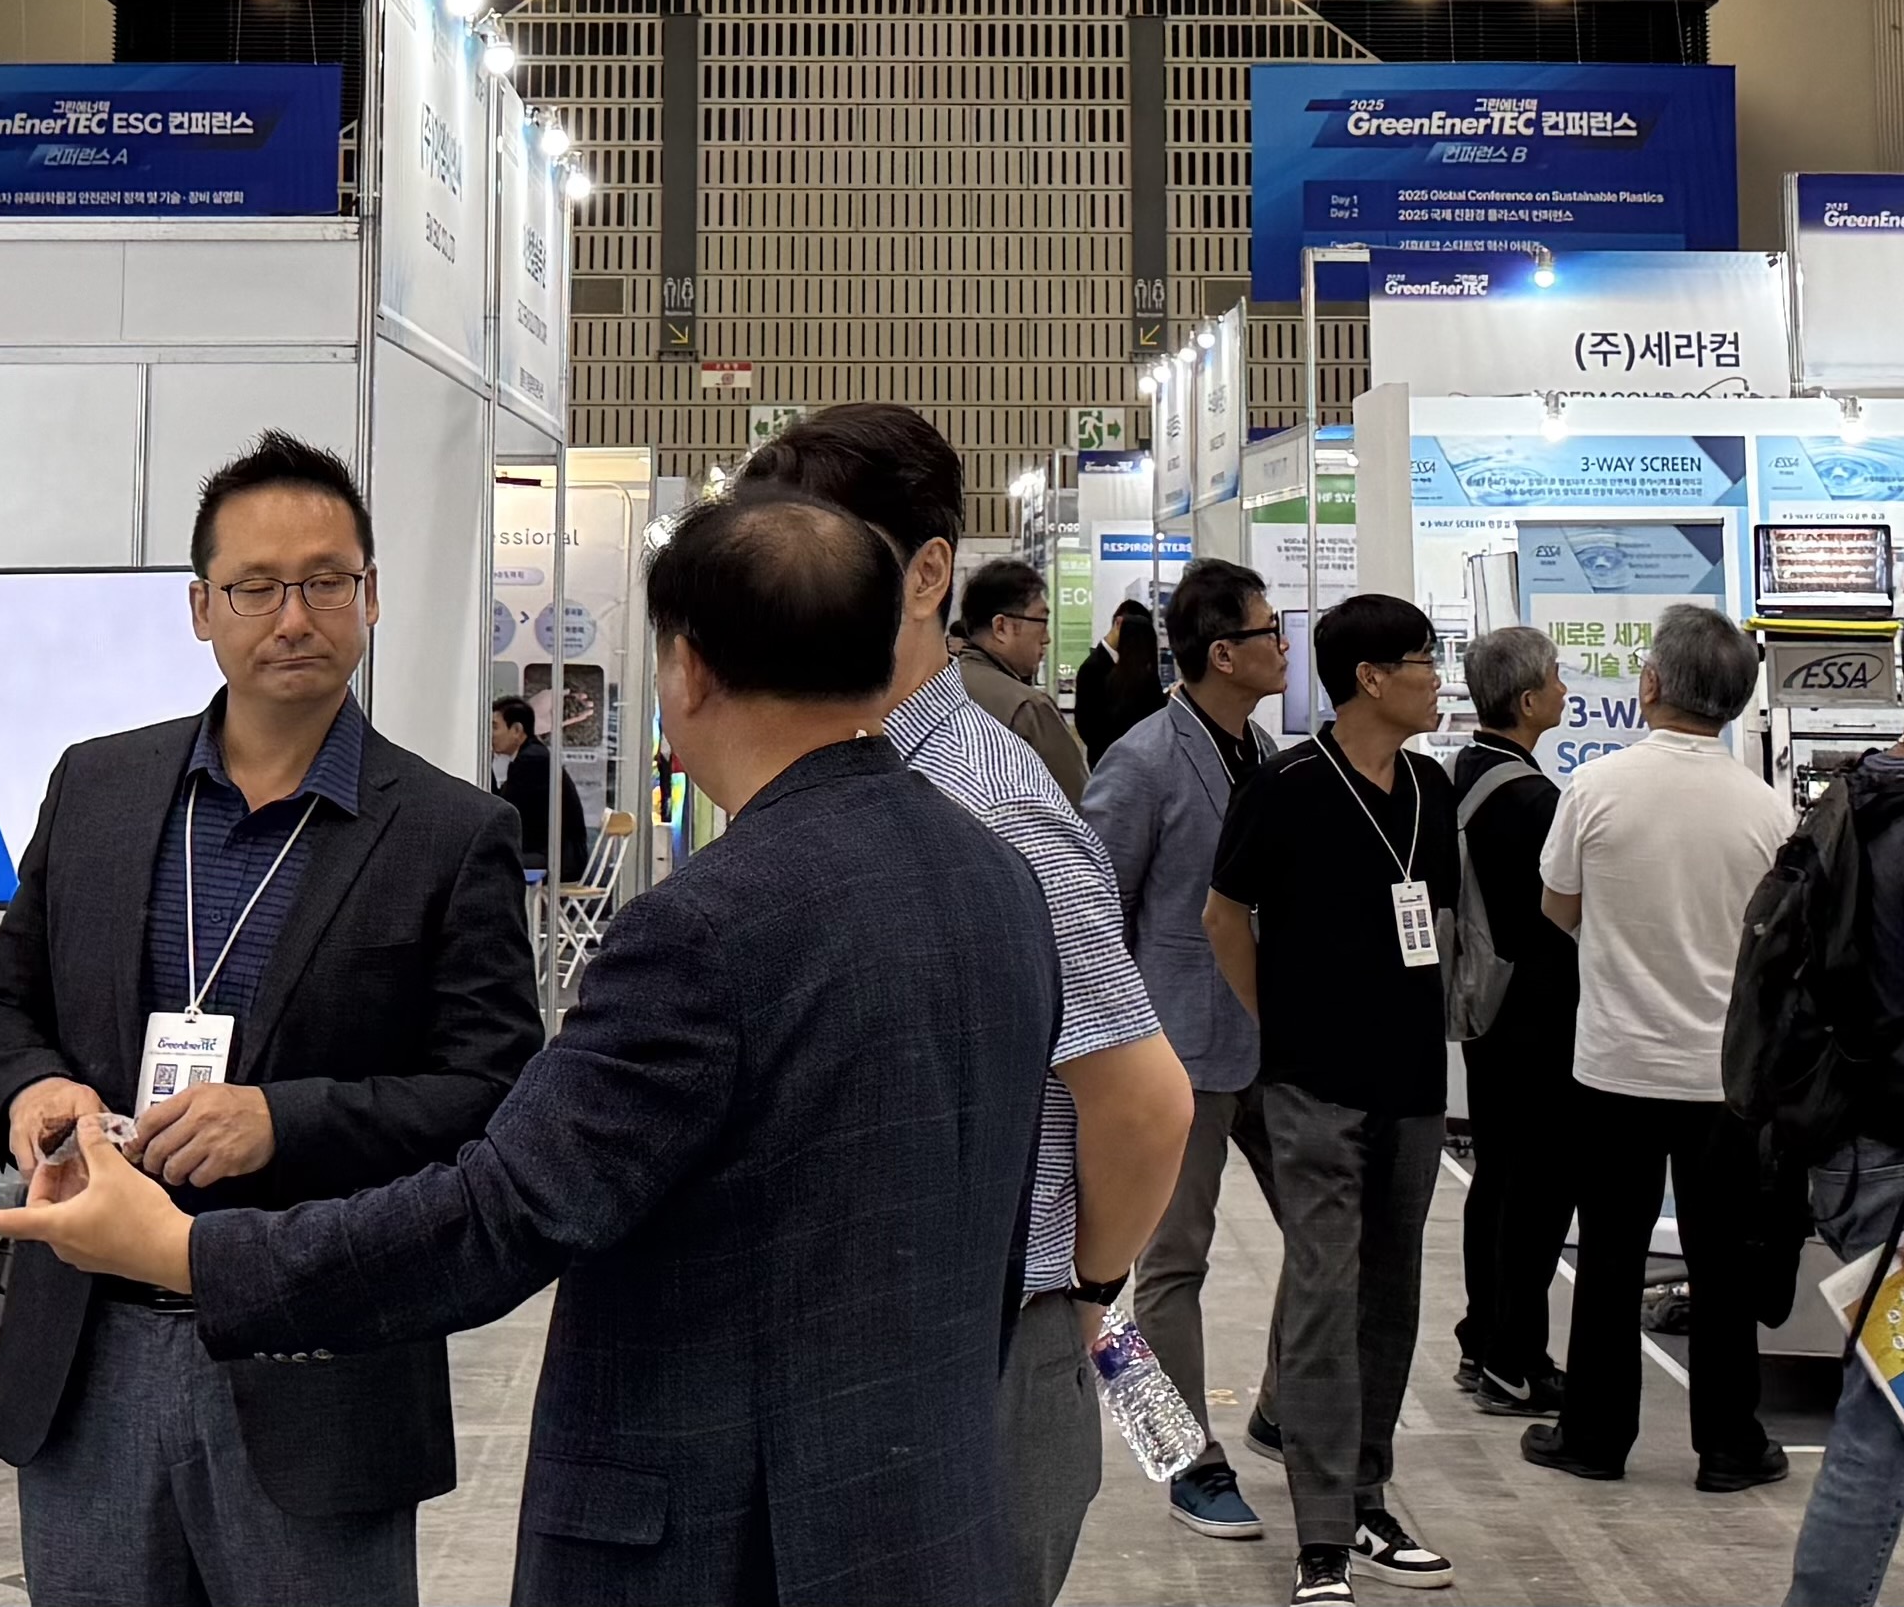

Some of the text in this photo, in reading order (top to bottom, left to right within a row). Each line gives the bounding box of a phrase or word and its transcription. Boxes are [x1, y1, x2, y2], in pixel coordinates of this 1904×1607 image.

[1350, 100, 1384, 111] 2025
[113, 113, 162, 134] ESG
[168, 111, 254, 136] 컨퍼런스
[1347, 110, 1637, 136] GreenEnerTEC 컨퍼런스
[44, 147, 128, 165] 컨퍼런스 A
[1442, 146, 1527, 164] 컨퍼런스 B
[1430, 190, 1466, 202] Global
[1468, 190, 1533, 202] Conference
[1535, 193, 1549, 202] on
[1552, 191, 1618, 203] Sustainable
[1619, 192, 1664, 204] Plastics
[1385, 281, 1487, 296] GreenEnerTEC
[1574, 331, 1741, 372] (주)세라컴
[1581, 457, 1702, 472] 3-WAY SCREEN
[1581, 652, 1620, 677] 기술
[1802, 662, 1871, 689] ESSA
